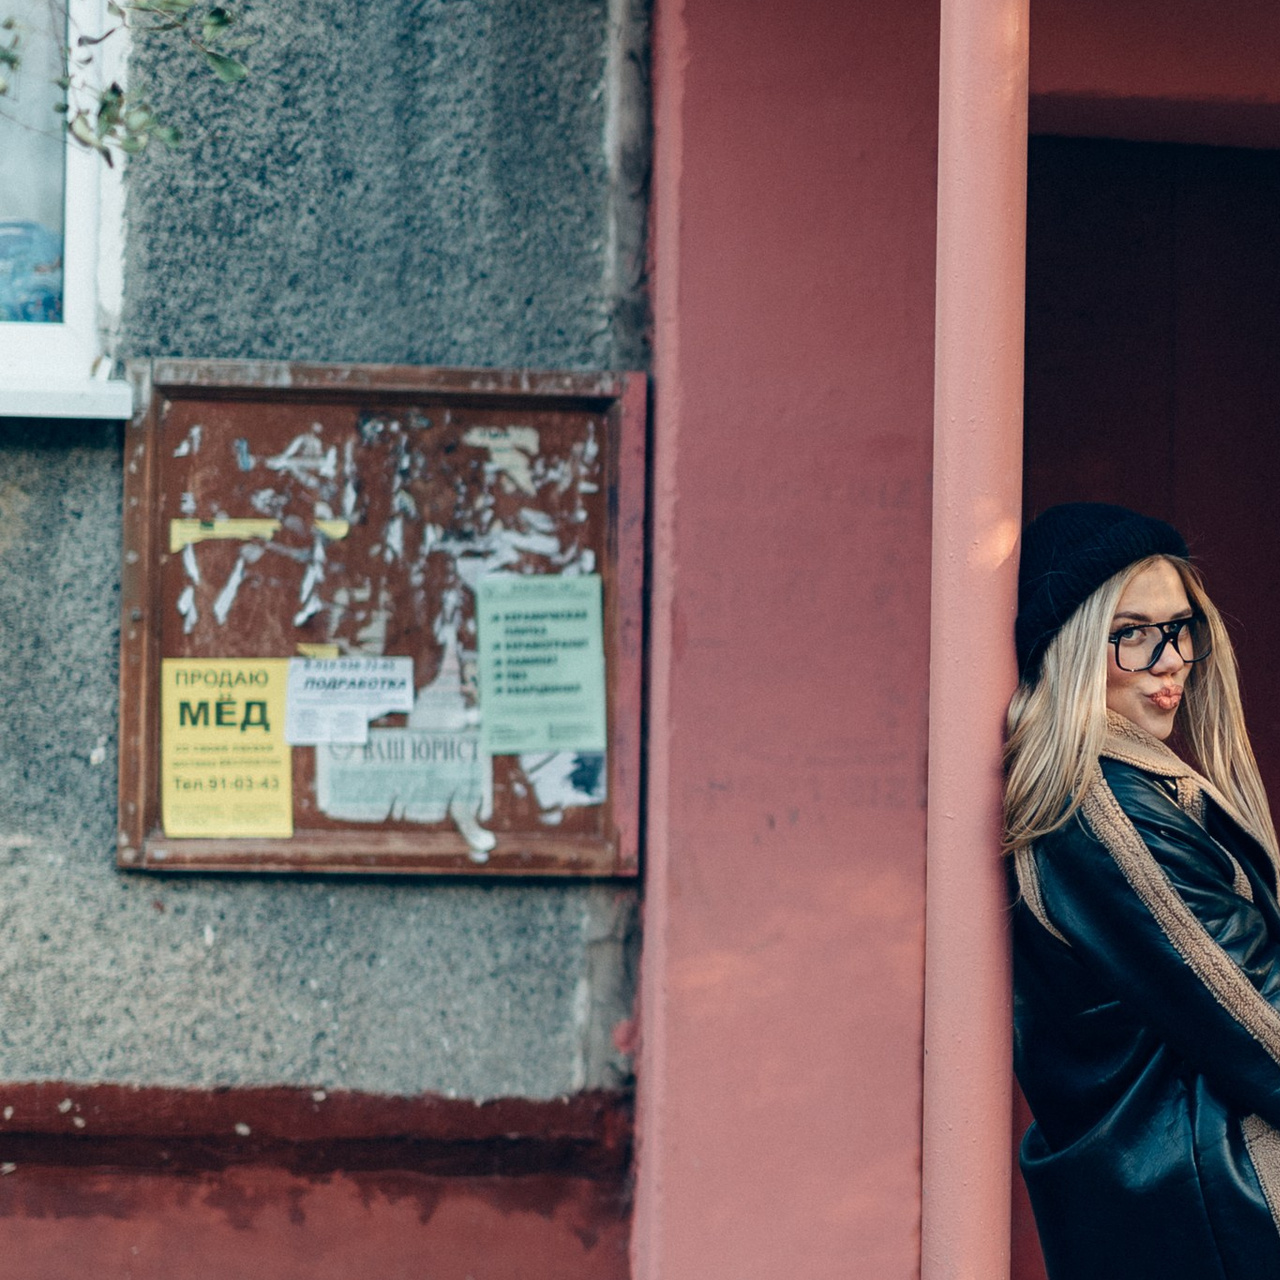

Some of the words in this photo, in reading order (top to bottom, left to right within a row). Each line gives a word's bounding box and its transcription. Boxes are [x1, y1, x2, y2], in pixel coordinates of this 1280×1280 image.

[174, 669, 270, 688] ПРОДАЮ
[303, 677, 407, 691] ПОДРАБОТКА
[178, 694, 271, 732] МЁД
[411, 736, 479, 761] ЮРИСТ
